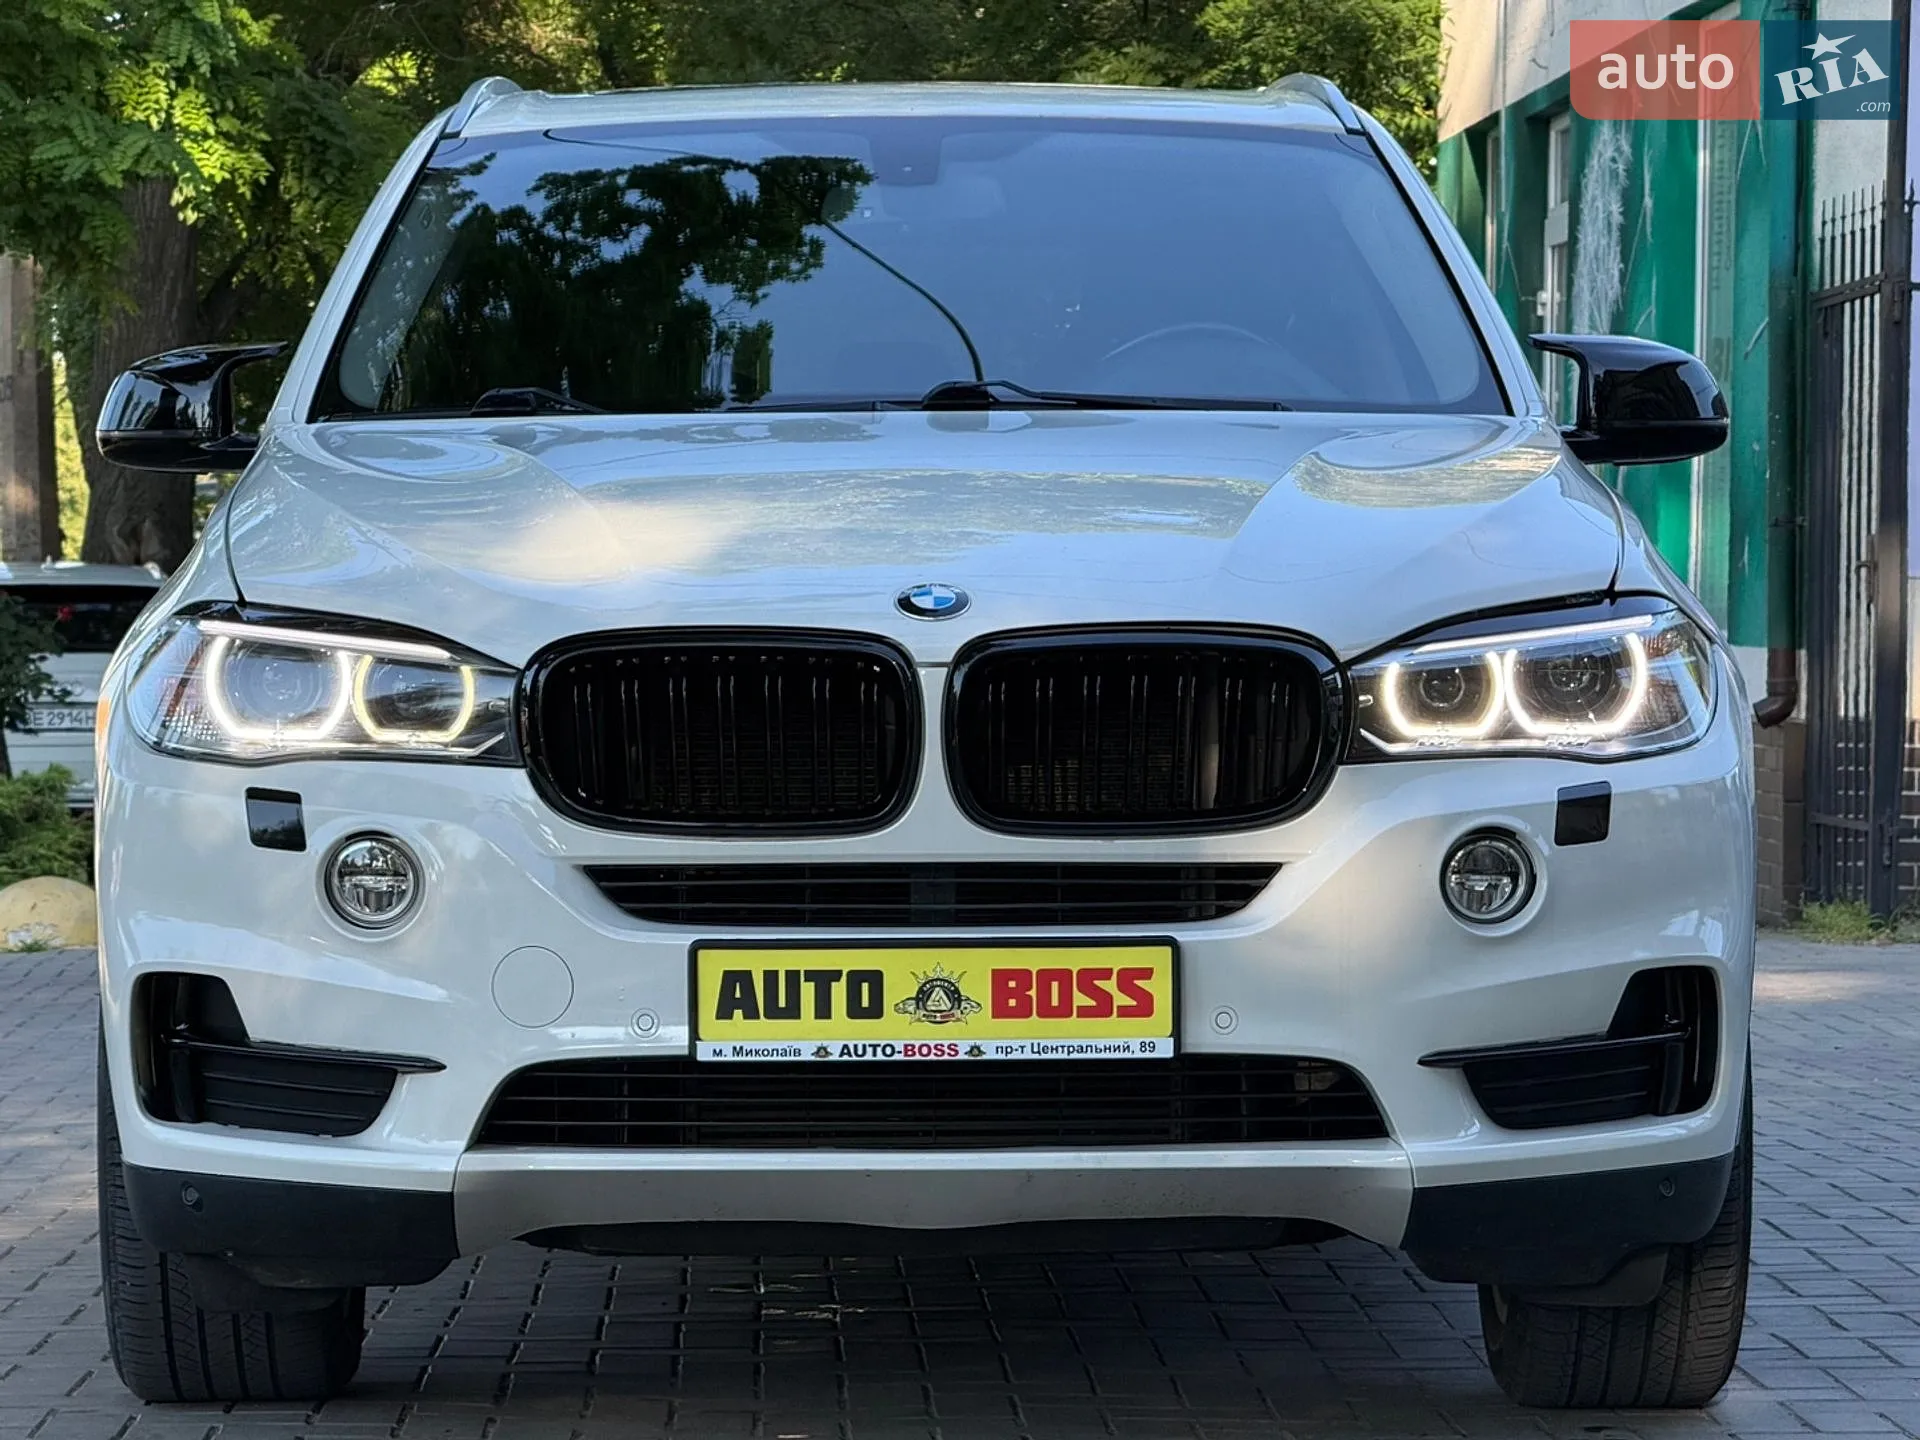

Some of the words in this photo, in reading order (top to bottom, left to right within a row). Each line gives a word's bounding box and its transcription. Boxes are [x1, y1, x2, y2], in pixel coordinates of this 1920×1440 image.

[715, 969, 884, 1020] AUTO
[991, 967, 1155, 1020] BOSS
[712, 1050, 727, 1058] м.
[732, 1045, 802, 1058] Миколаїв
[838, 1043, 960, 1058] AUTO-BOSS
[995, 1044, 1026, 1056] пр-т
[1030, 1040, 1135, 1056] Центральний,
[1139, 1041, 1156, 1053] 89
